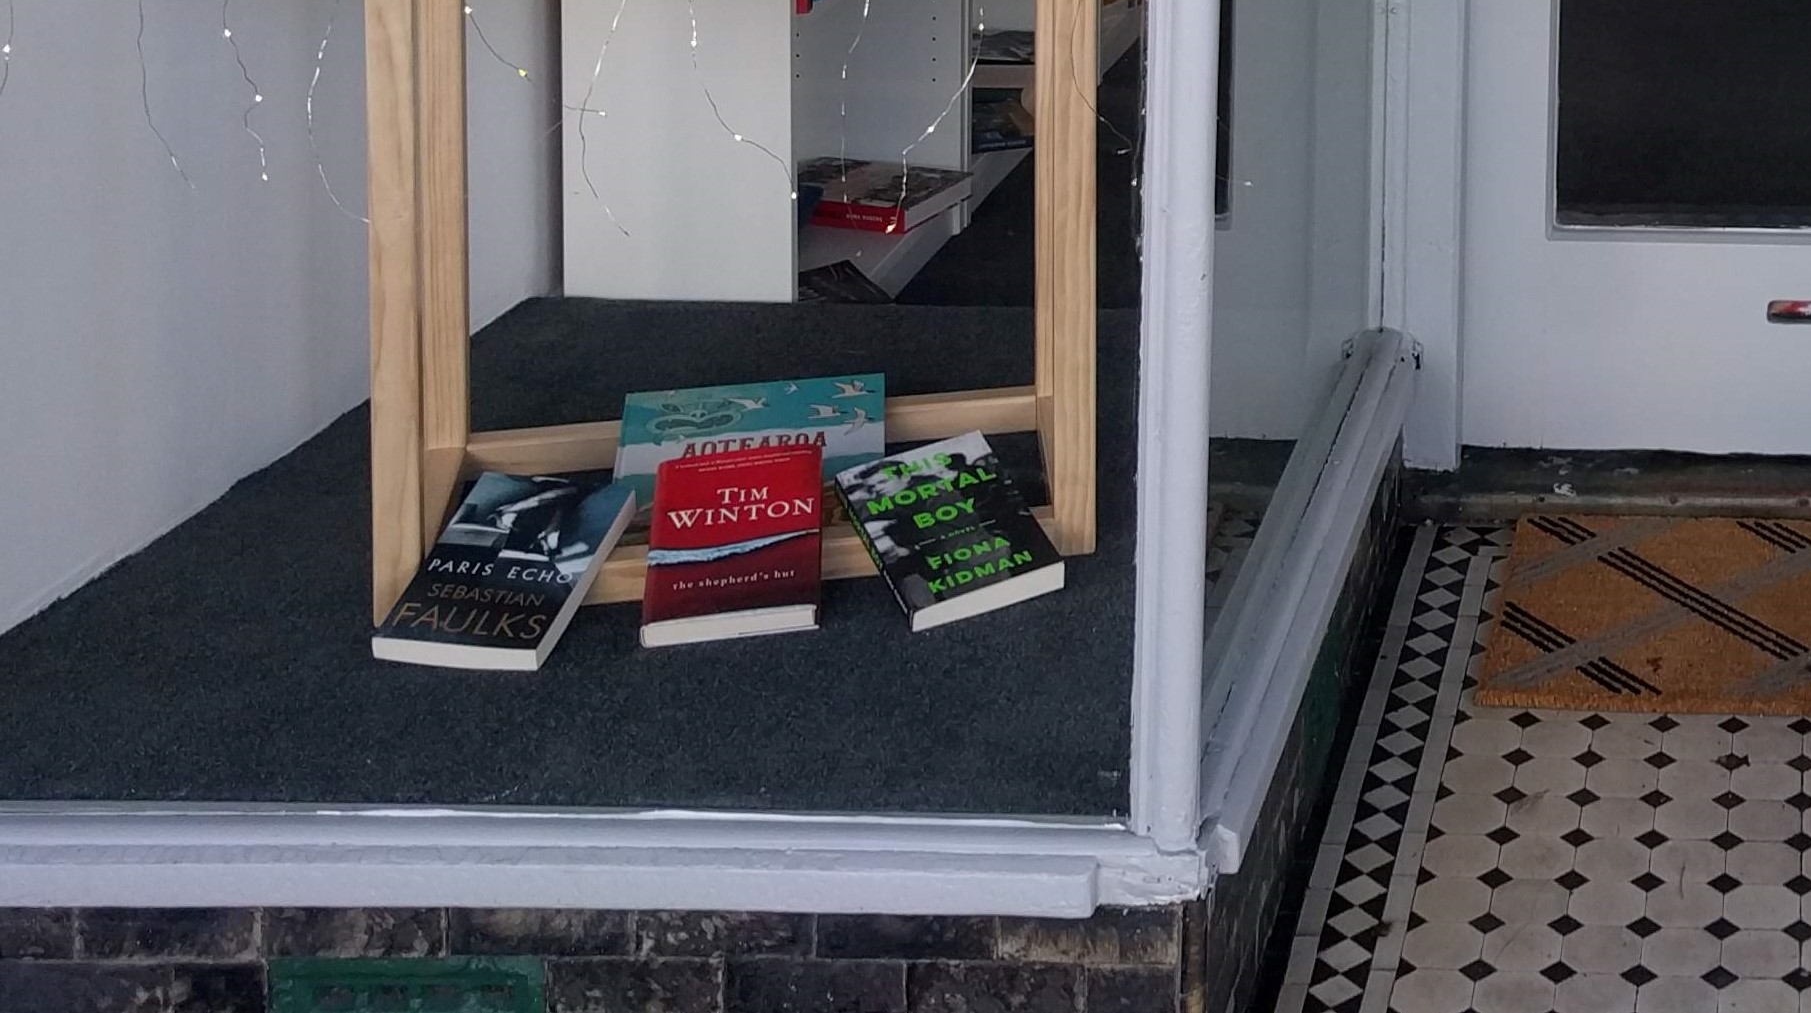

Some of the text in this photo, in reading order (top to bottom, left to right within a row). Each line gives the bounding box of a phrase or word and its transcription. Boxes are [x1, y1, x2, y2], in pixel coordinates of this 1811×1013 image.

[681, 430, 828, 459] AOTEAROA
[881, 451, 953, 481] THIS
[716, 486, 770, 505] TIM
[866, 466, 998, 516] MORTAL
[666, 496, 816, 531] WINTON
[912, 497, 977, 530] BOY
[924, 536, 1011, 571] FIONA
[426, 557, 575, 584] PARIS ECHO
[672, 568, 797, 592] the shepherd's hut
[926, 549, 1035, 595] KIDMAN
[426, 582, 546, 608] SEBASTIAN
[391, 601, 549, 640] FAULKS
